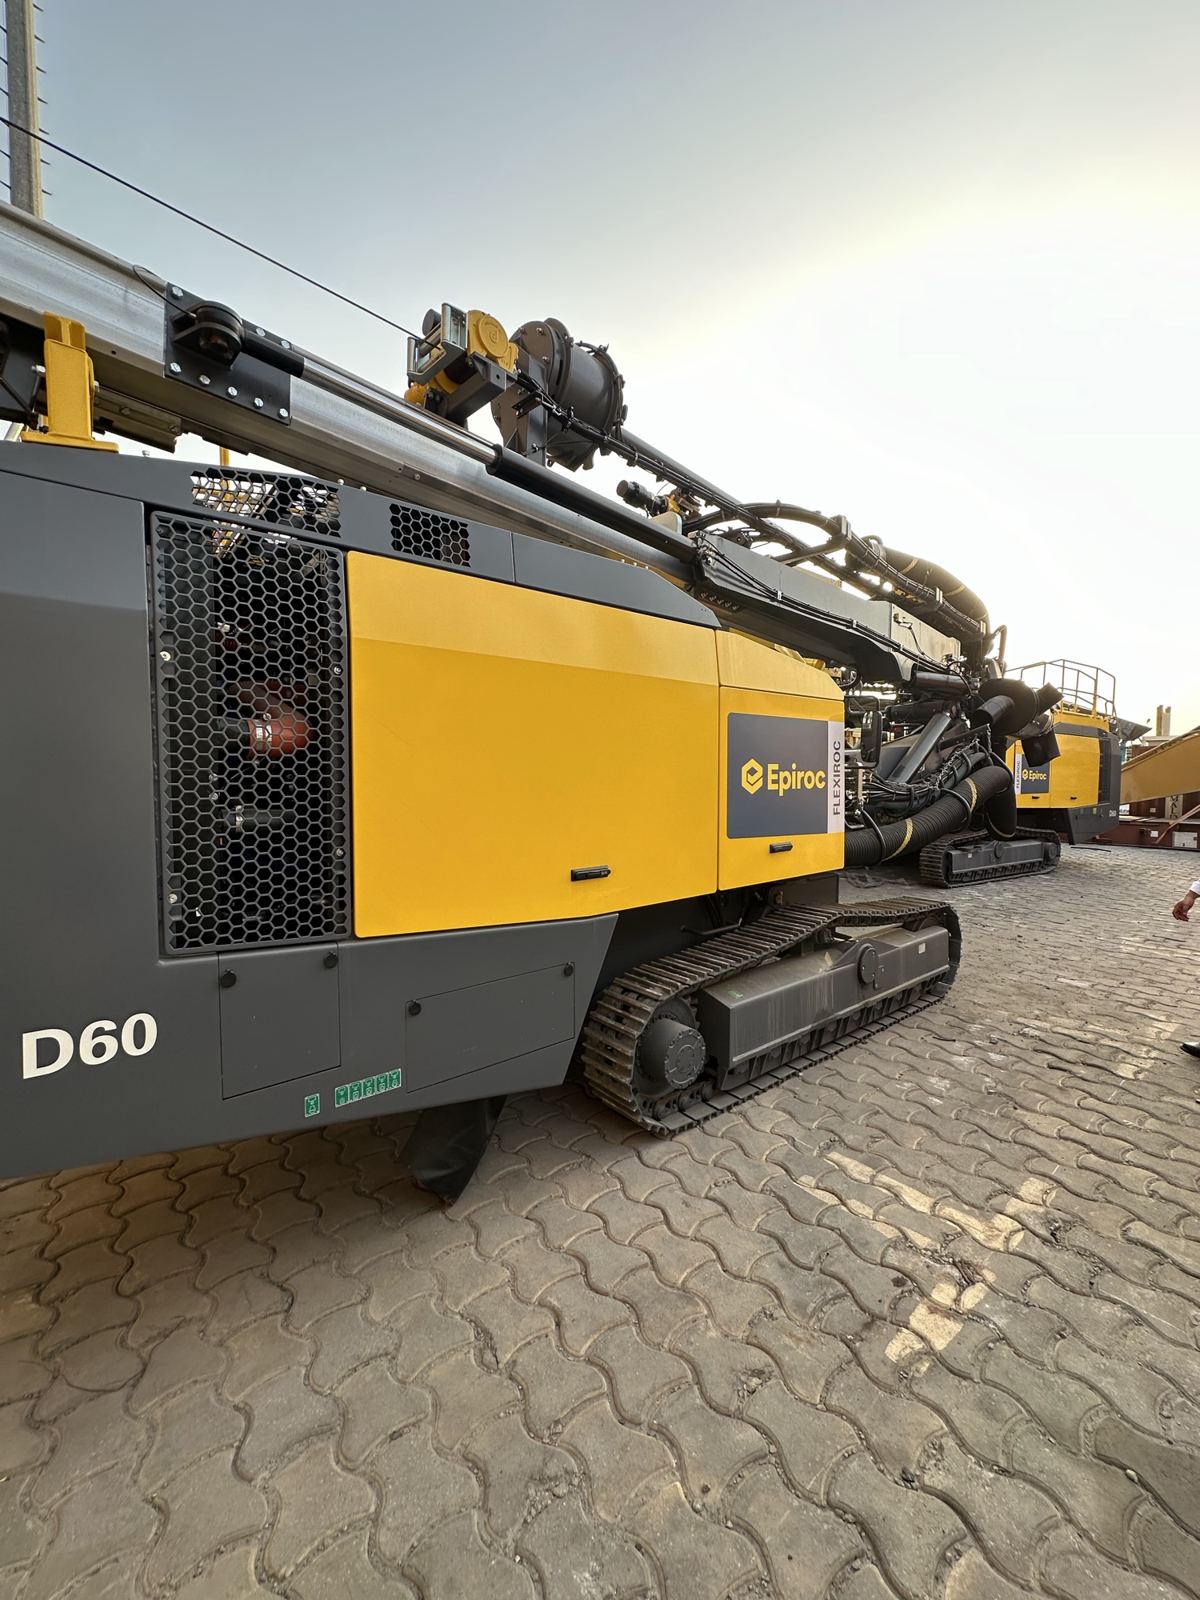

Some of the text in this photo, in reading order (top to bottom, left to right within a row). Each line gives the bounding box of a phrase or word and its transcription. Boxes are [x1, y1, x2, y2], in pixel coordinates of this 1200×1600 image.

[767, 762, 826, 797] Epiroc
[833, 740, 841, 815] FLEXIROC
[1029, 770, 1047, 782] Epiroc
[22, 1012, 158, 1080] D60
